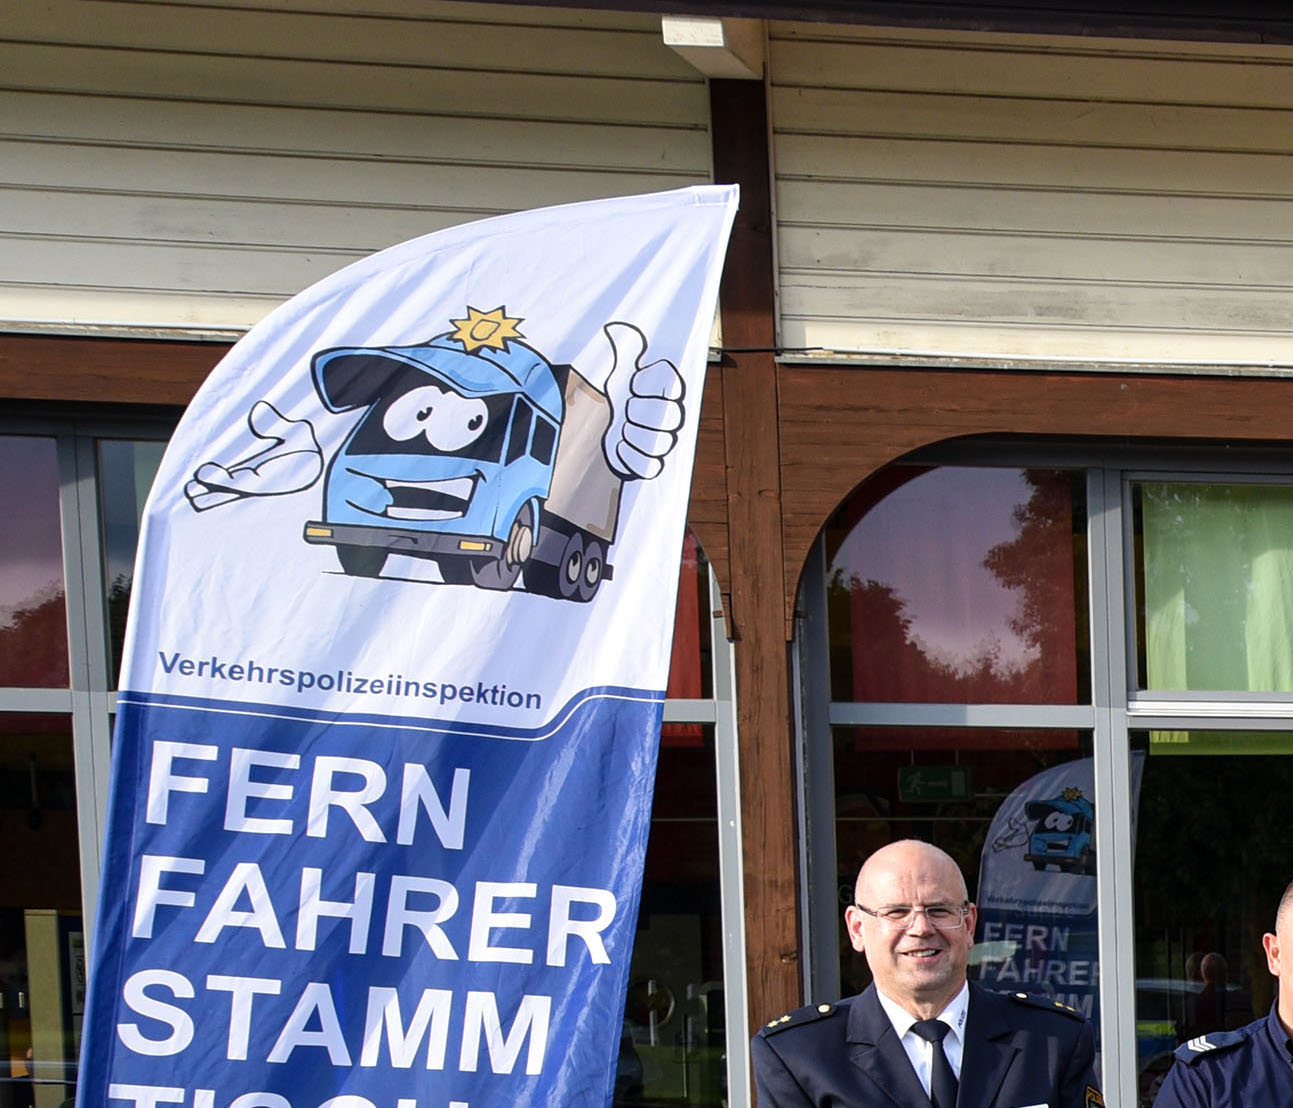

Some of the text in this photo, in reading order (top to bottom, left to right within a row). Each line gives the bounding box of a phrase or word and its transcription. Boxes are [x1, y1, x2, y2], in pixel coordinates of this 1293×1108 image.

[158, 651, 542, 711] Verkehrspolizeiinspektion
[145, 740, 470, 849] FERN
[132, 854, 616, 968] FAHRER
[116, 969, 552, 1077] STAMM
